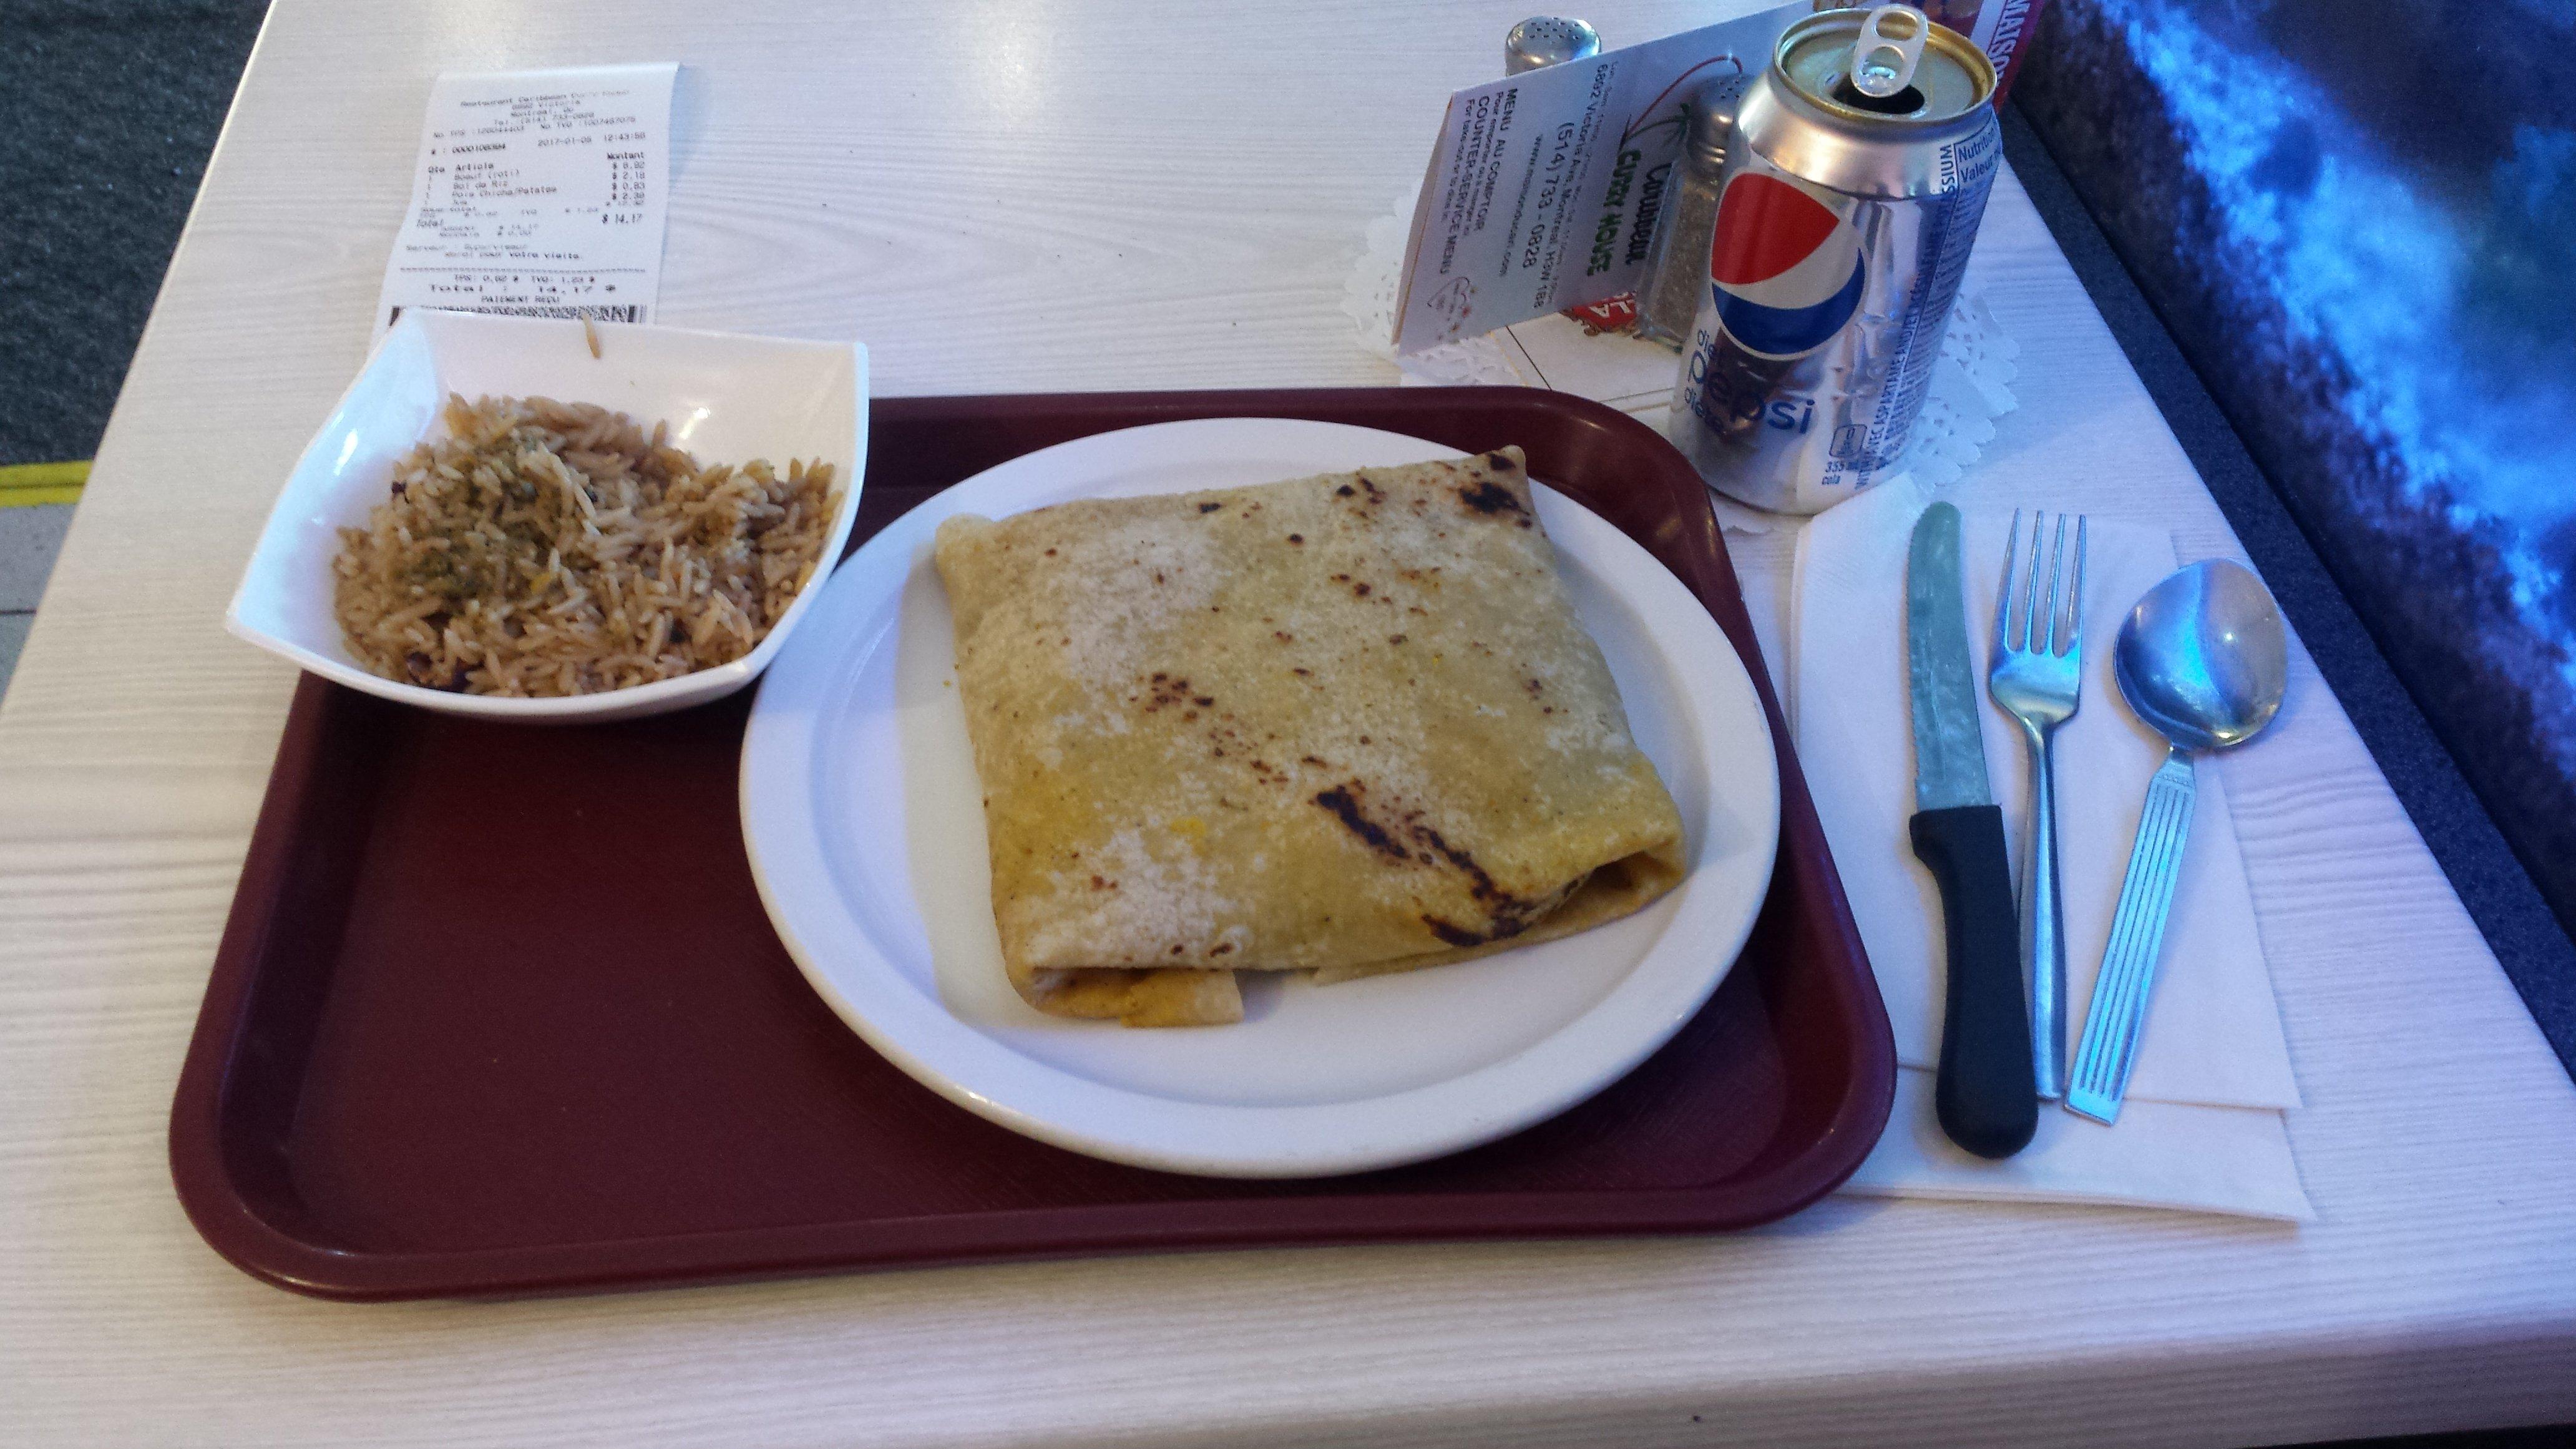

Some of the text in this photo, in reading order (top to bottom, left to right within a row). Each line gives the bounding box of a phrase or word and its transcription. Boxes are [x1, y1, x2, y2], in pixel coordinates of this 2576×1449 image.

[1989, 0, 2030, 86] MAISO
[1463, 98, 1475, 117] For
[1448, 94, 1491, 233] COUNTER-SERVICE
[1475, 87, 1518, 230] MENU AU COMPTOIR
[1544, 120, 1575, 172] (514)
[1537, 175, 1560, 209] 733
[615, 213, 643, 225] 14.17
[1439, 235, 1458, 275] MENU
[1521, 223, 1546, 268] 0828
[1585, 212, 1624, 276] HOUSE
